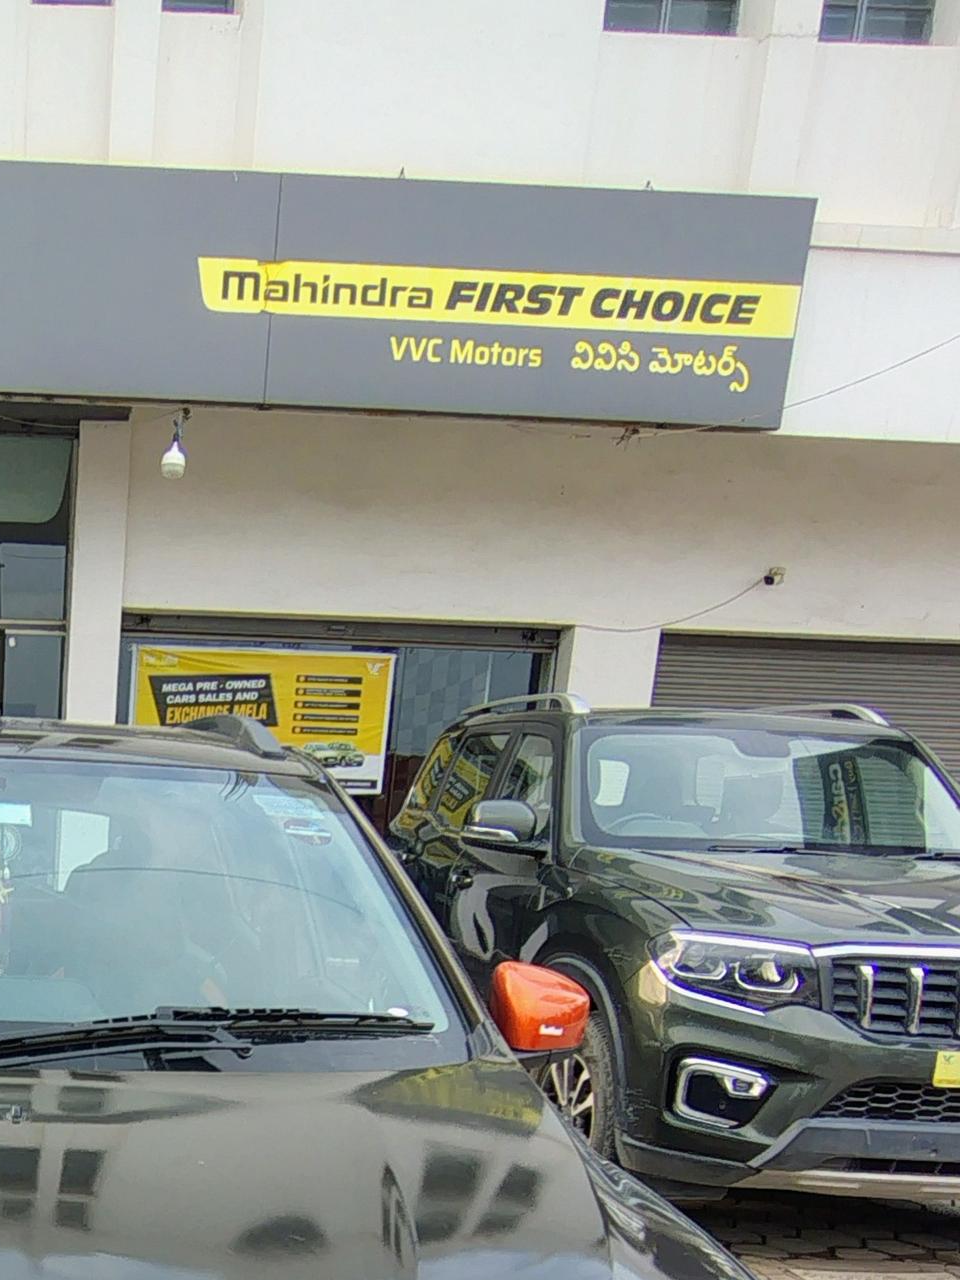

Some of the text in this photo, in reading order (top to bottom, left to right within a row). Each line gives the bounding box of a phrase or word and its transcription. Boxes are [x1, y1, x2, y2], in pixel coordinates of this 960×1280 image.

[222, 270, 762, 326] Mahindra FIRST CHOICE
[390, 336, 542, 369] VVC Motors
[571, 341, 640, 372] వివిసి
[162, 682, 194, 693] MEGA
[196, 681, 218, 691] PRE
[225, 679, 266, 690] OWNED
[166, 691, 258, 704] CARS SALES AND
